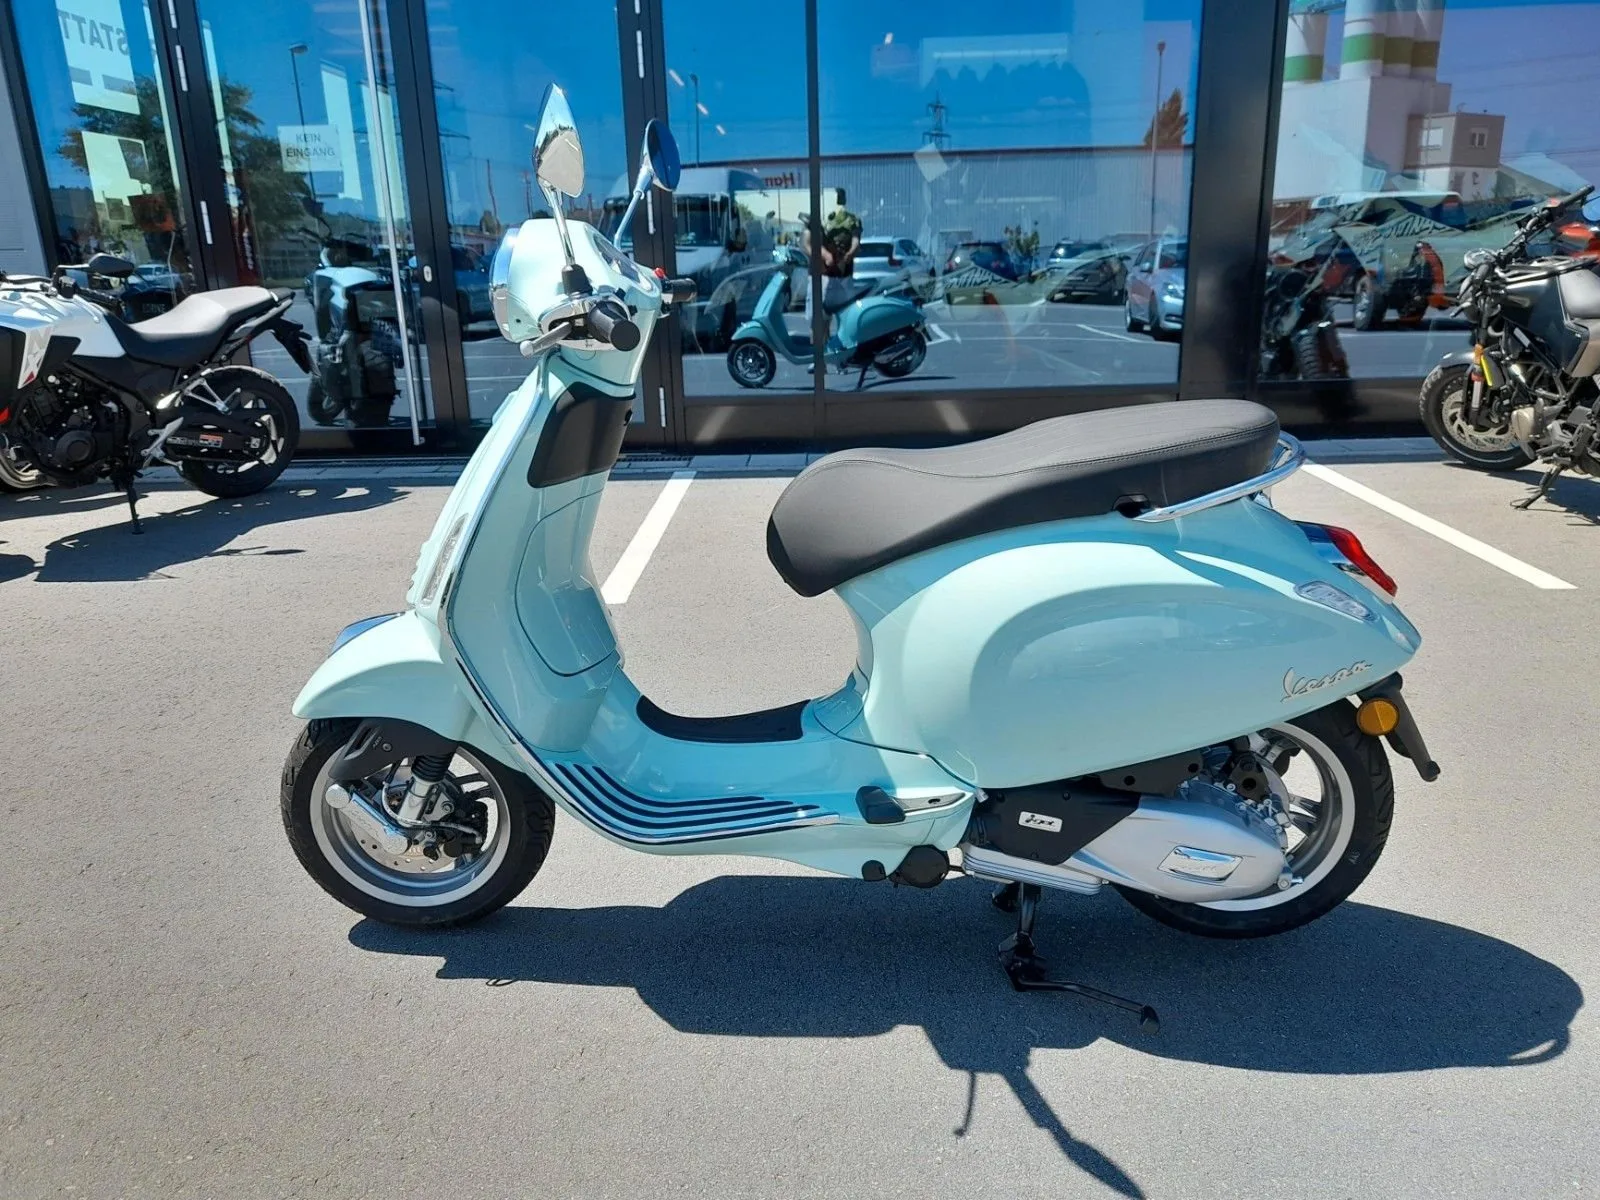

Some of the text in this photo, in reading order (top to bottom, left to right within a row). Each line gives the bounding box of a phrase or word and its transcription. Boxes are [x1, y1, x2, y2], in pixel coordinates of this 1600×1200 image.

[295, 132, 321, 143] KEIN
[286, 147, 336, 158] EINGANG
[1279, 659, 1373, 705] Vespa
